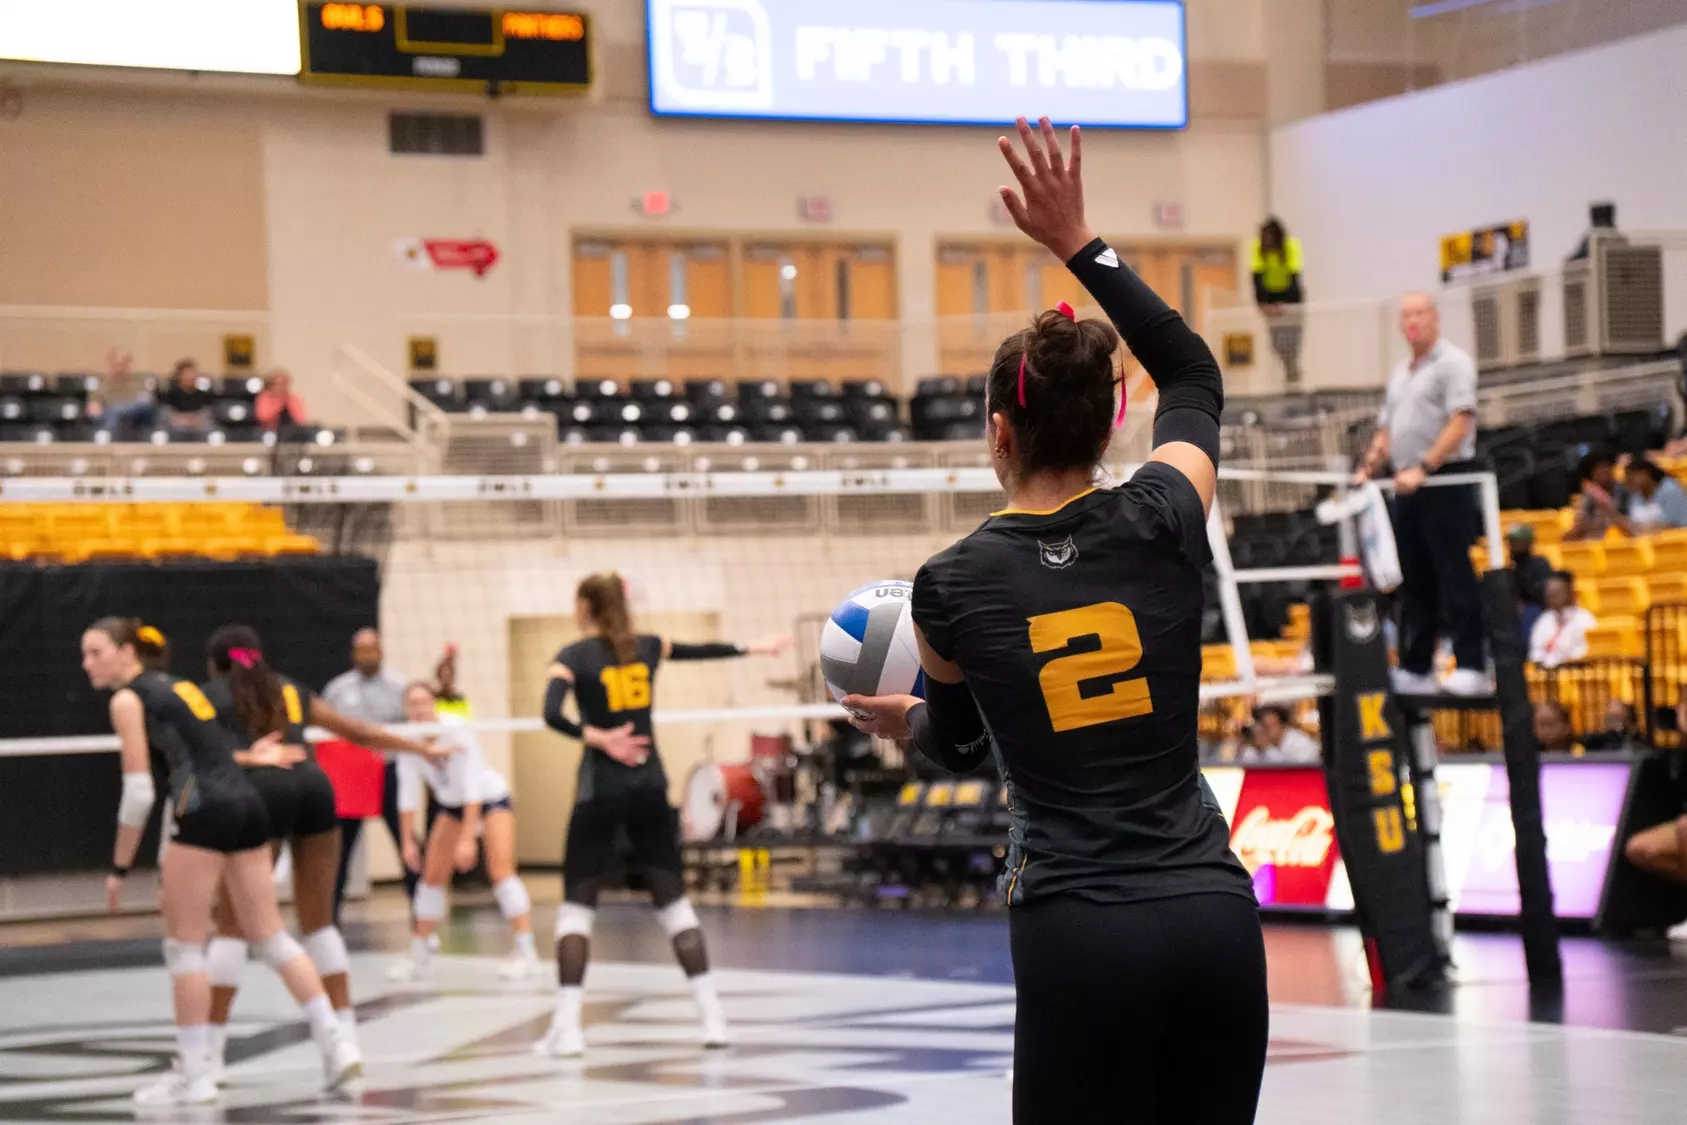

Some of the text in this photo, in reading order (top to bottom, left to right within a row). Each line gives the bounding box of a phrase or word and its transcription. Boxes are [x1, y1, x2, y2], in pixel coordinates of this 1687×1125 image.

[795, 26, 1183, 90] FIFTH THIRD
[600, 661, 650, 712] 16
[1026, 601, 1153, 732] 2
